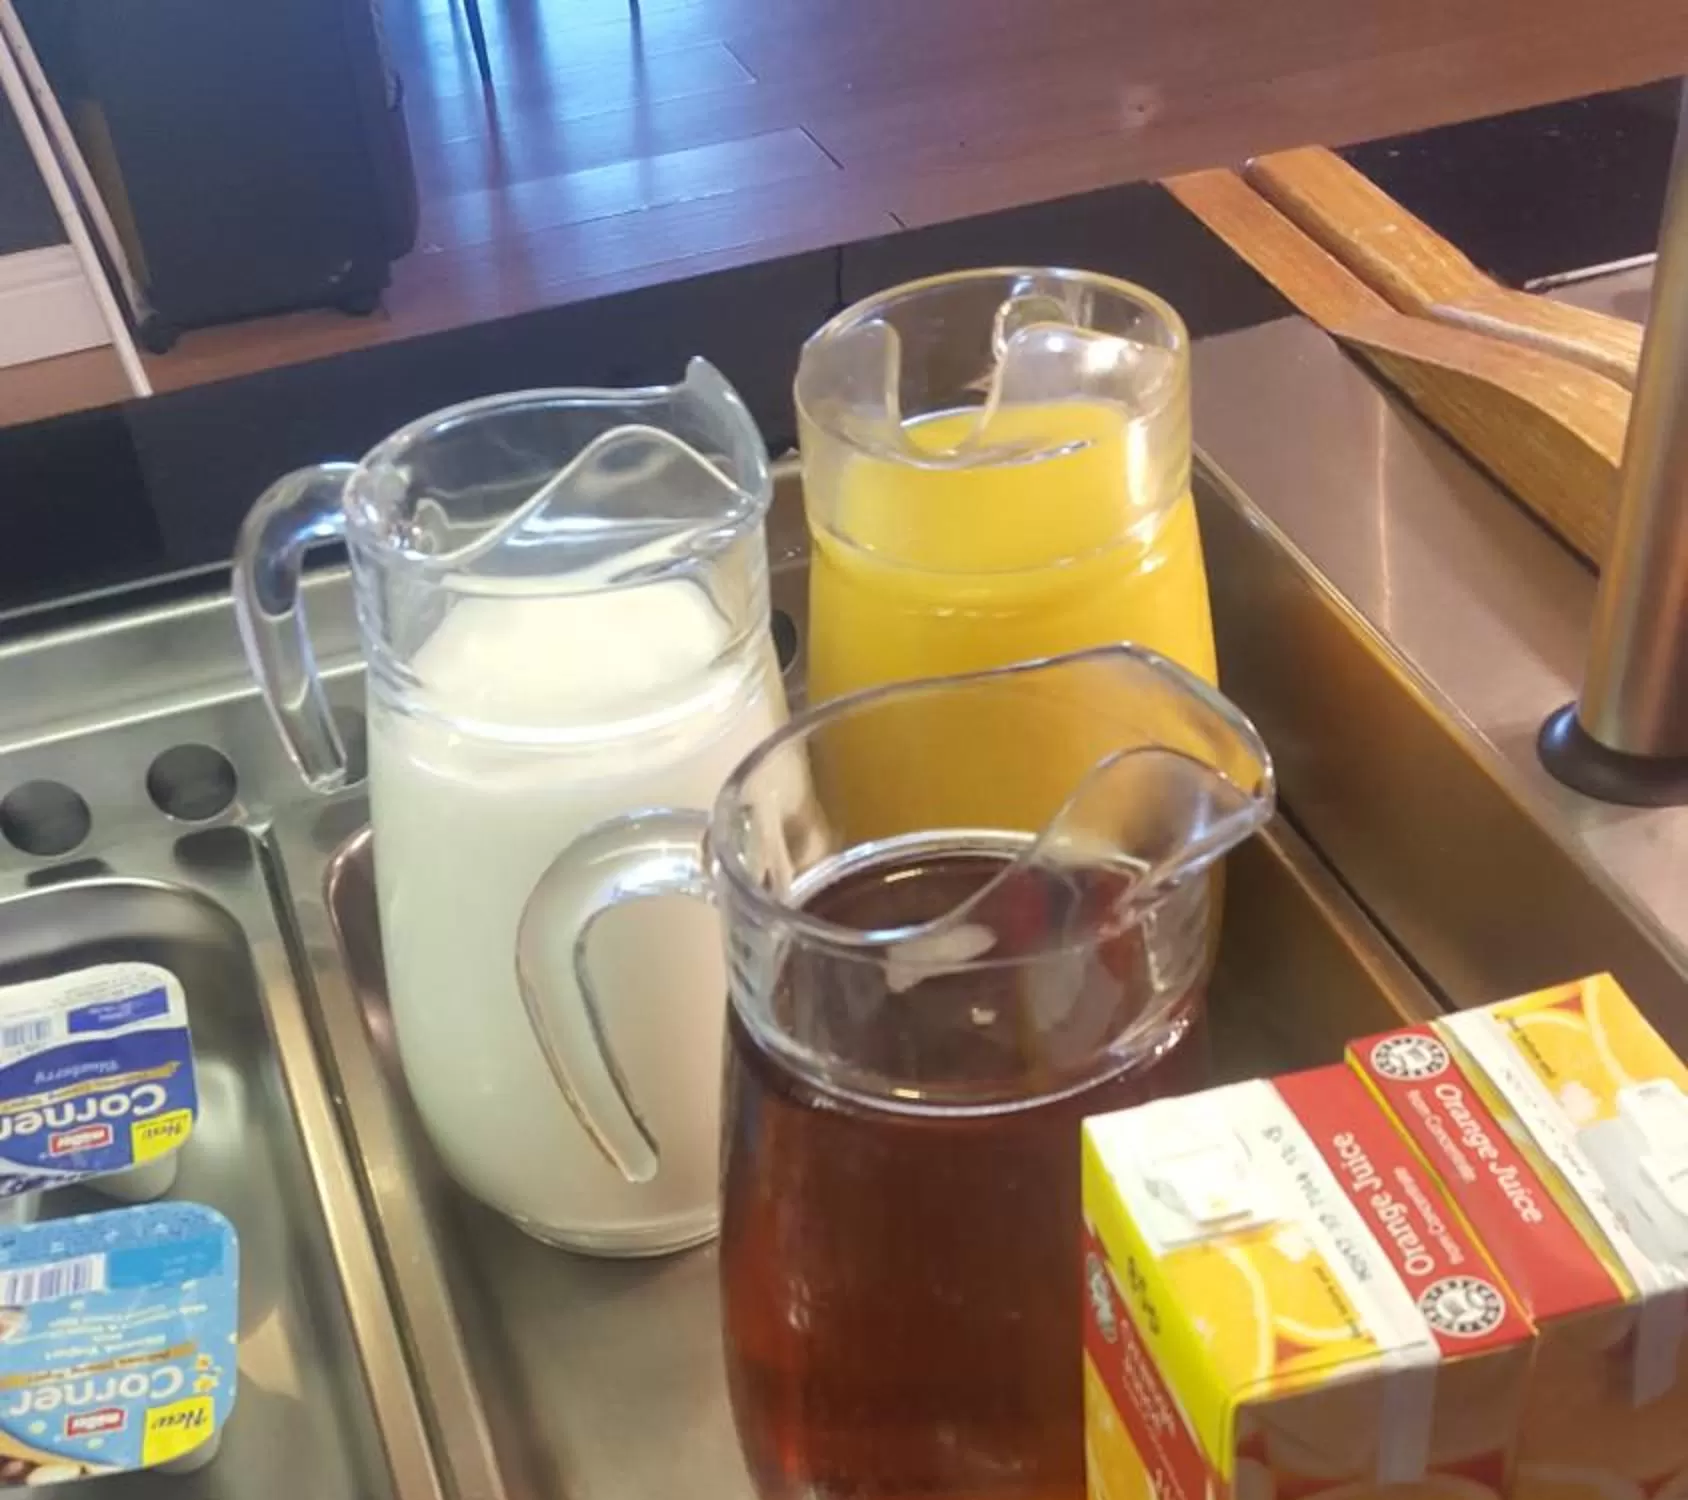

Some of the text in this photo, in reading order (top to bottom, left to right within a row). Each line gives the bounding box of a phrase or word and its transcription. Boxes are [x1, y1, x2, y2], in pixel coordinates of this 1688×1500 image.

[0, 1083, 167, 1141] Corner
[1435, 1083, 1544, 1223] Orange Juice
[1333, 1131, 1435, 1277] Orange Juice
[9, 1366, 185, 1416] Corner
